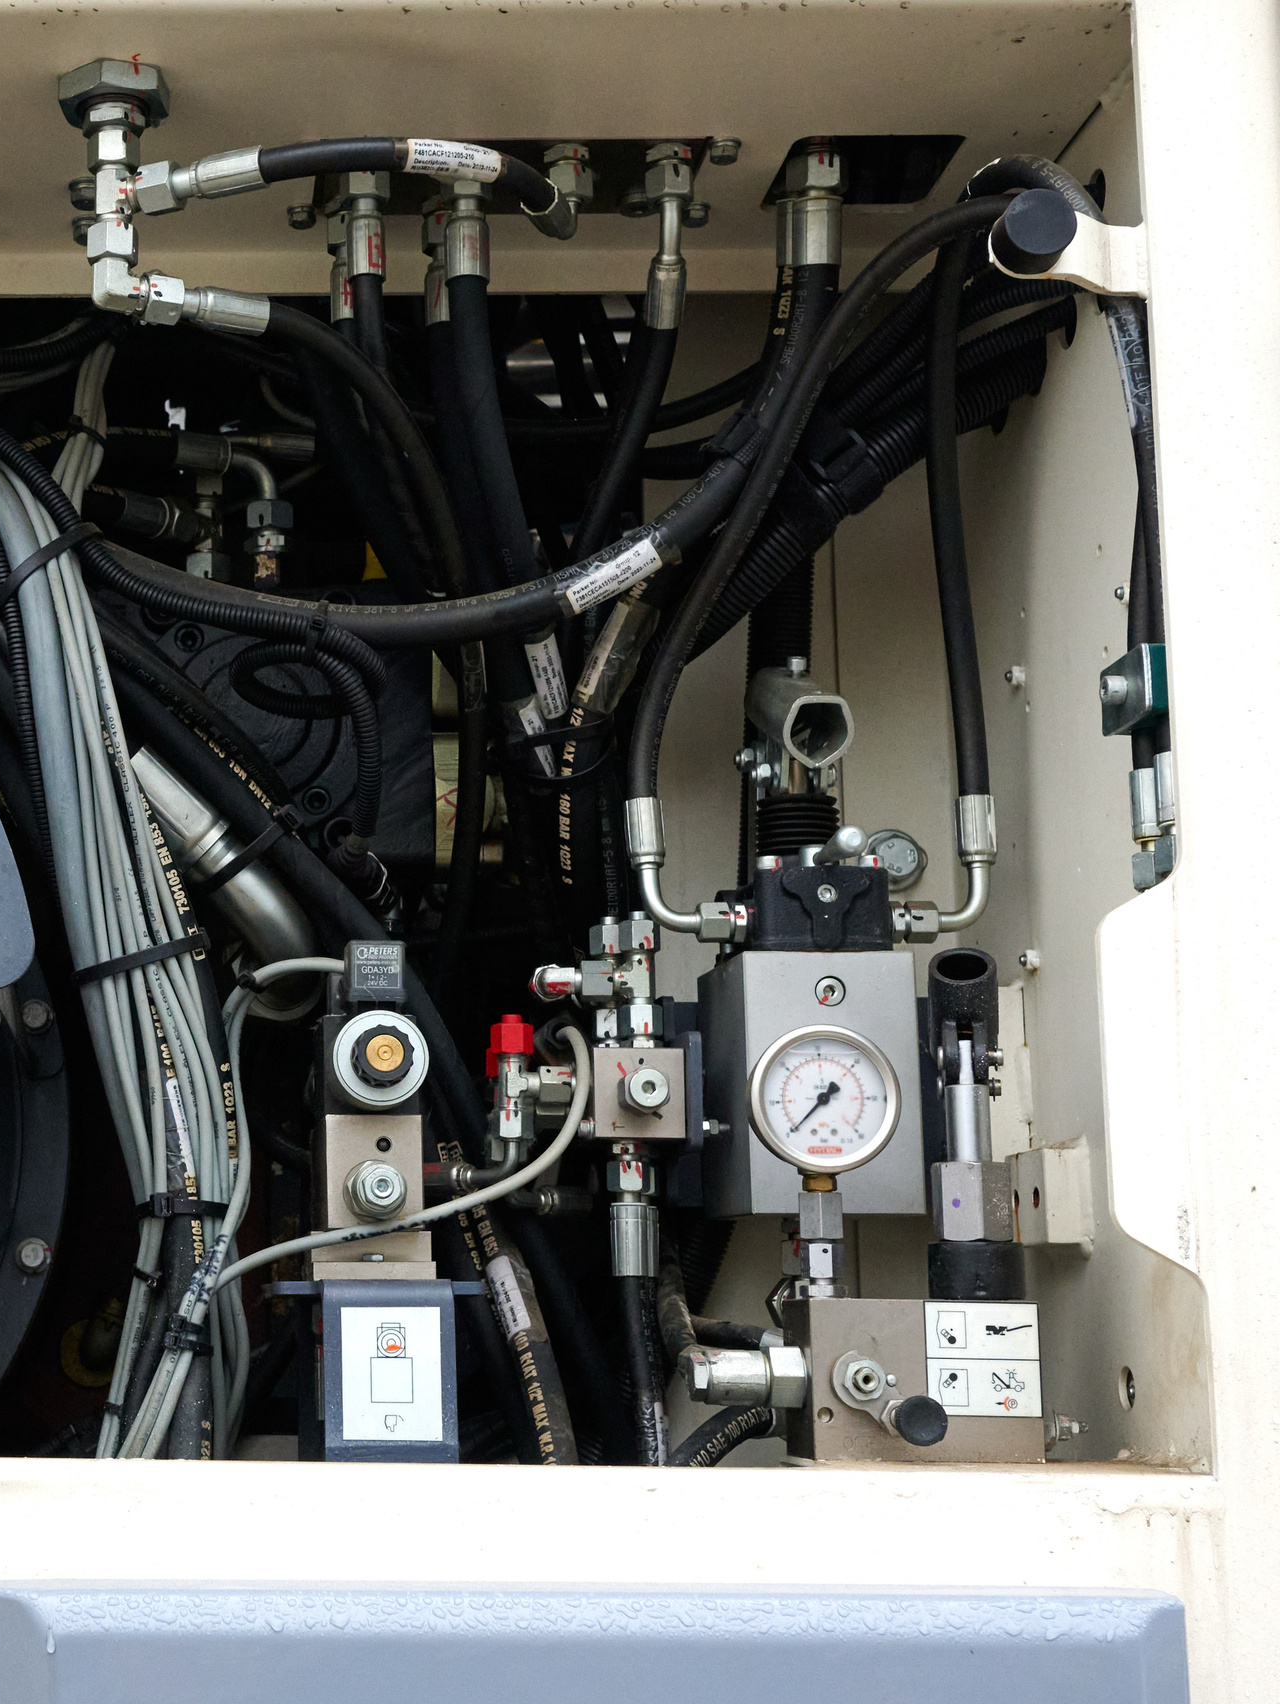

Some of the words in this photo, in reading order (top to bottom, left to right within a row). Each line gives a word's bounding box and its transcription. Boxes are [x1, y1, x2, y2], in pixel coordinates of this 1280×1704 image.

[149, 822, 165, 847] 853
[157, 846, 173, 867] EN
[165, 868, 191, 915] 730105
[369, 947, 398, 956] PETERS
[220, 1062, 232, 1073] S
[226, 1119, 238, 1147] BAR
[191, 1219, 205, 1265] 730105
[519, 1349, 537, 1381] R1AT
[531, 1402, 550, 1432] MAX
[706, 1431, 729, 1455] SAE
[723, 1420, 743, 1443] 100
